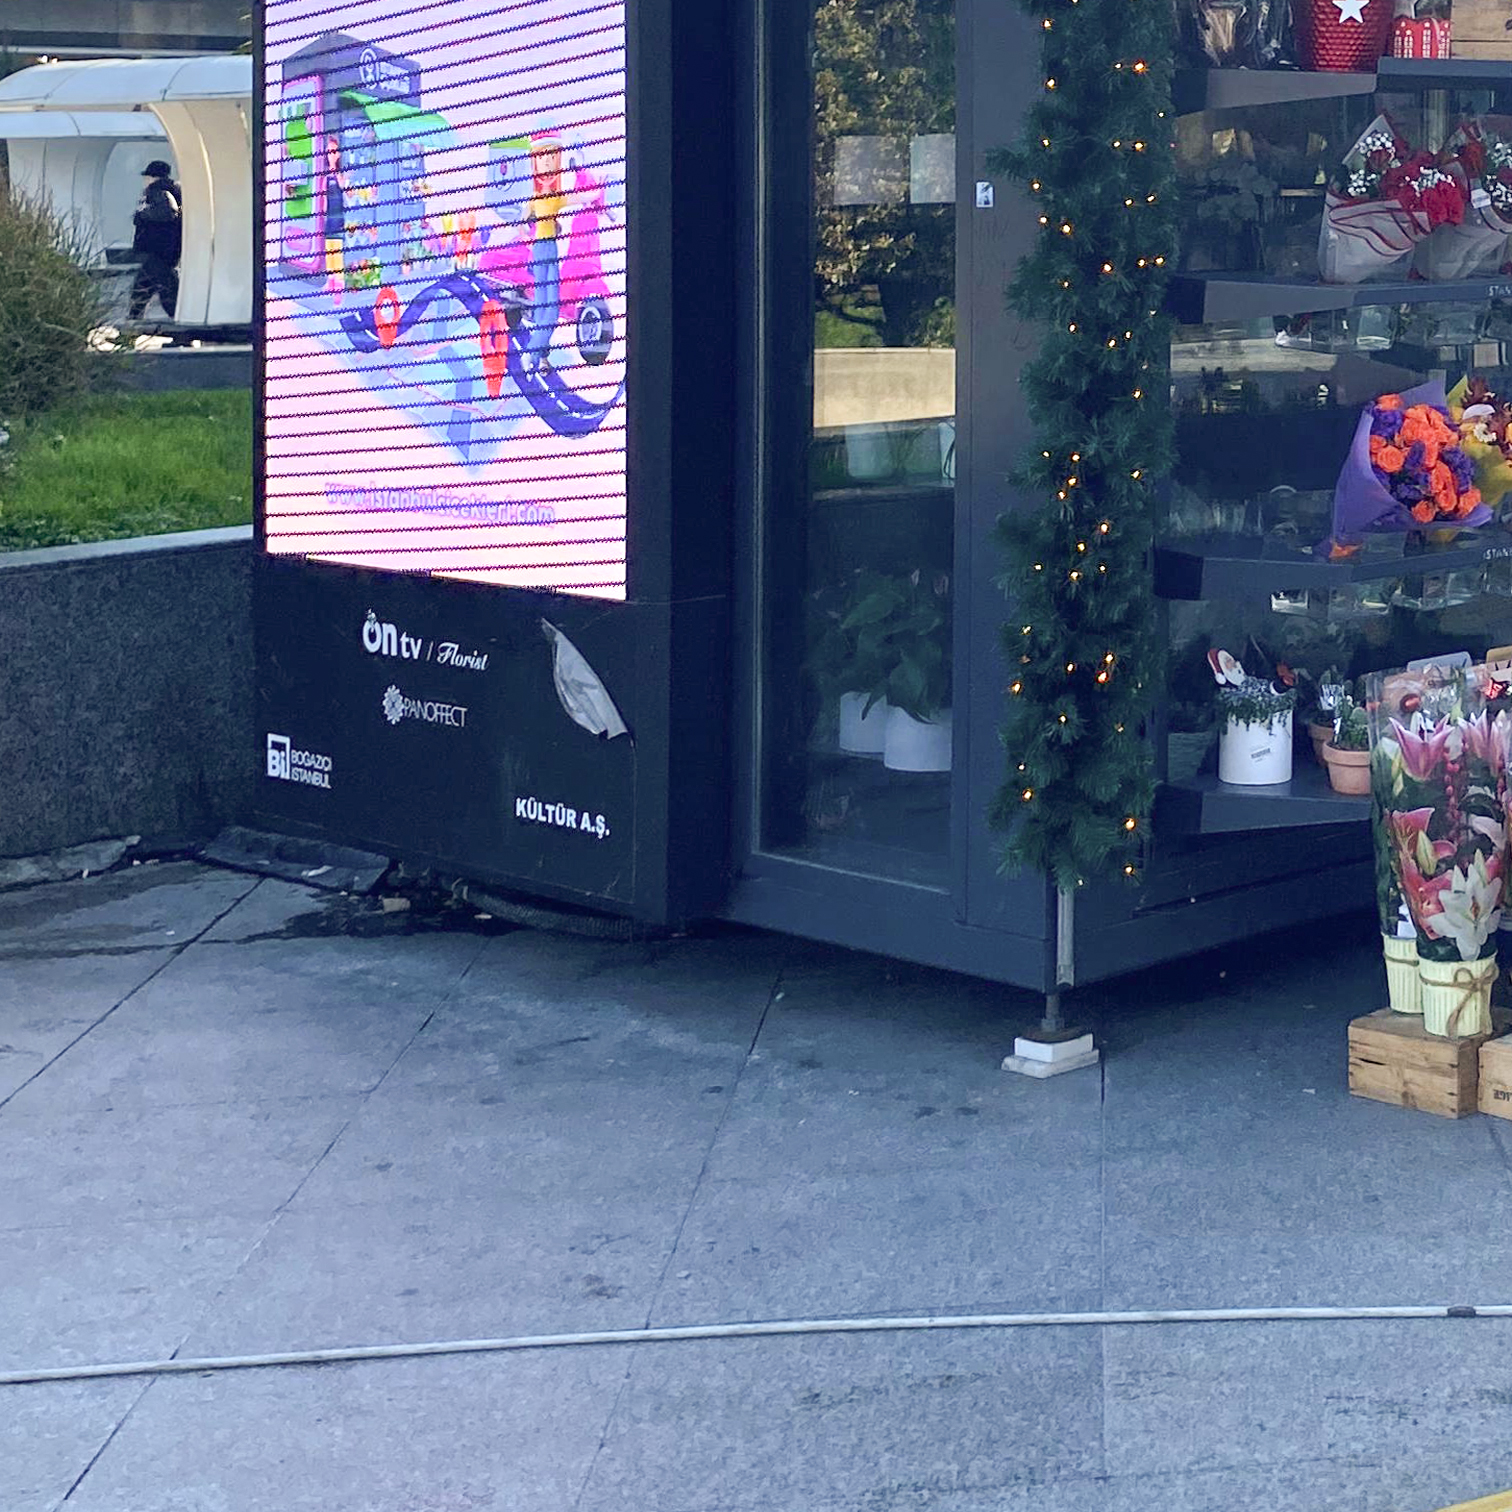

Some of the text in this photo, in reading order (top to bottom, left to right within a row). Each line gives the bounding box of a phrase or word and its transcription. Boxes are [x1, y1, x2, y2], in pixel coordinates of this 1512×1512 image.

[437, 642, 489, 670] Florist
[515, 796, 611, 839] KÜLTÜR A.Ş.
